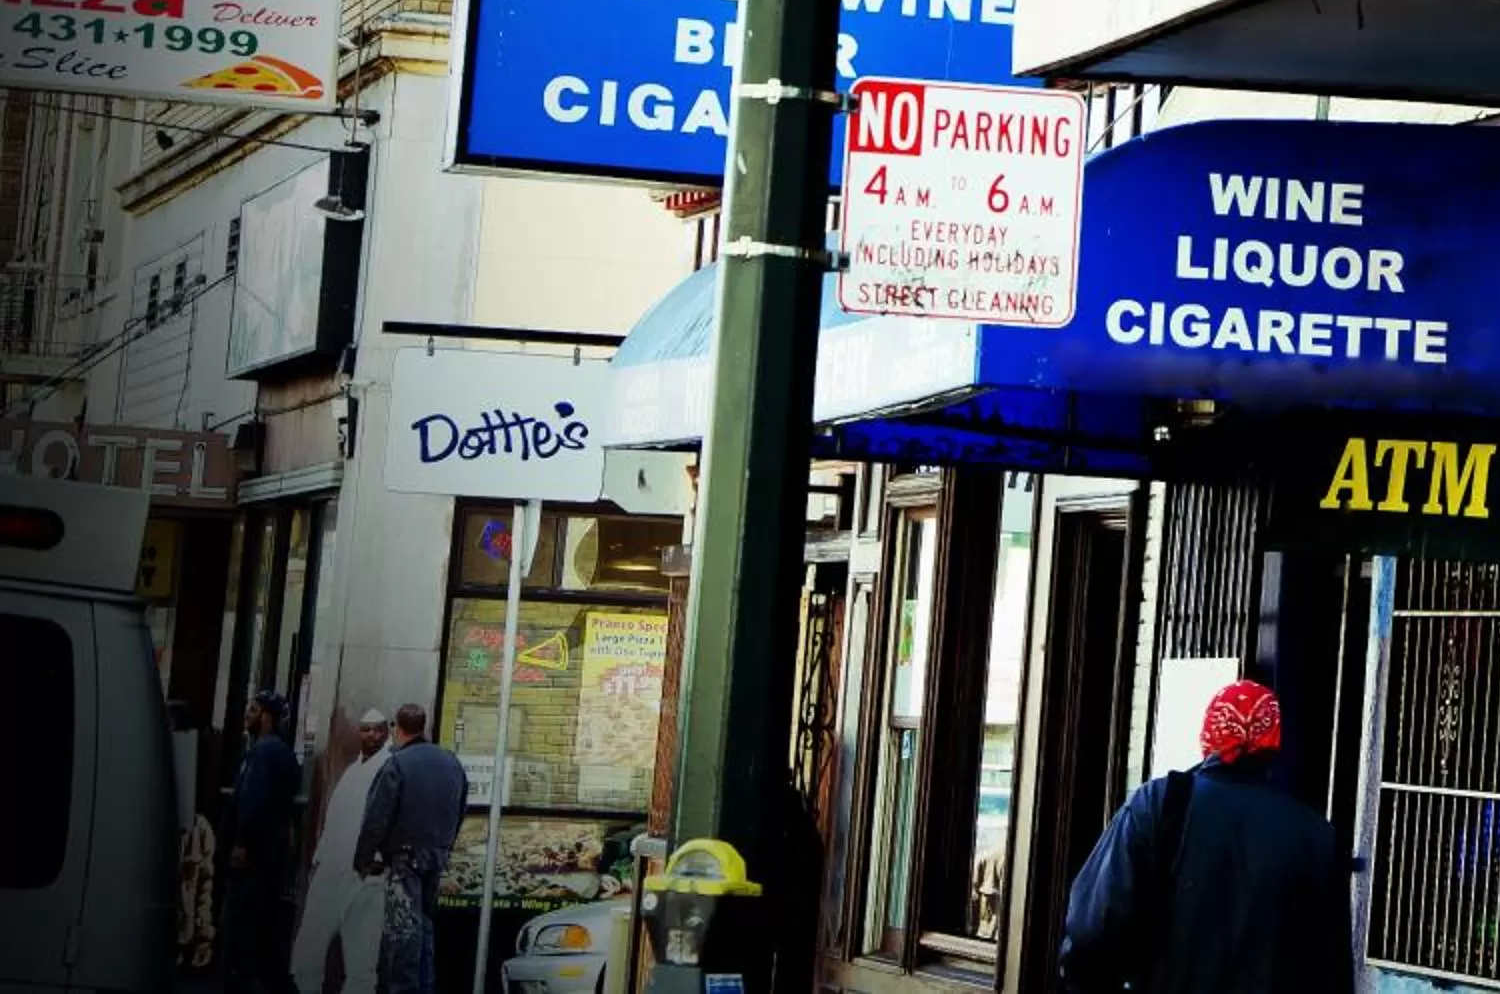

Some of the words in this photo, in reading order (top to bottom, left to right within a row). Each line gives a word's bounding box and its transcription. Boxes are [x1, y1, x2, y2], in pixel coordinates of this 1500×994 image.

[212, 2, 319, 28] Deliver
[13, 47, 129, 79] Slice
[674, 18, 858, 78] BR
[543, 75, 730, 137] CIGA
[857, 91, 920, 151] NO
[933, 109, 1071, 158] PARKING
[864, 165, 888, 205] 4
[987, 174, 1009, 213] 6
[1209, 173, 1364, 226] WINE
[911, 220, 1009, 244] EVERYDAY
[855, 242, 959, 270] INCLUDING
[967, 251, 1060, 276] HOLIDAYS
[1176, 235, 1405, 293] LIQUOR
[858, 283, 940, 307] STREET
[947, 289, 1053, 315] CLEANING
[1105, 299, 1448, 364] CIGARETTE
[1320, 437, 1496, 518] ATM
